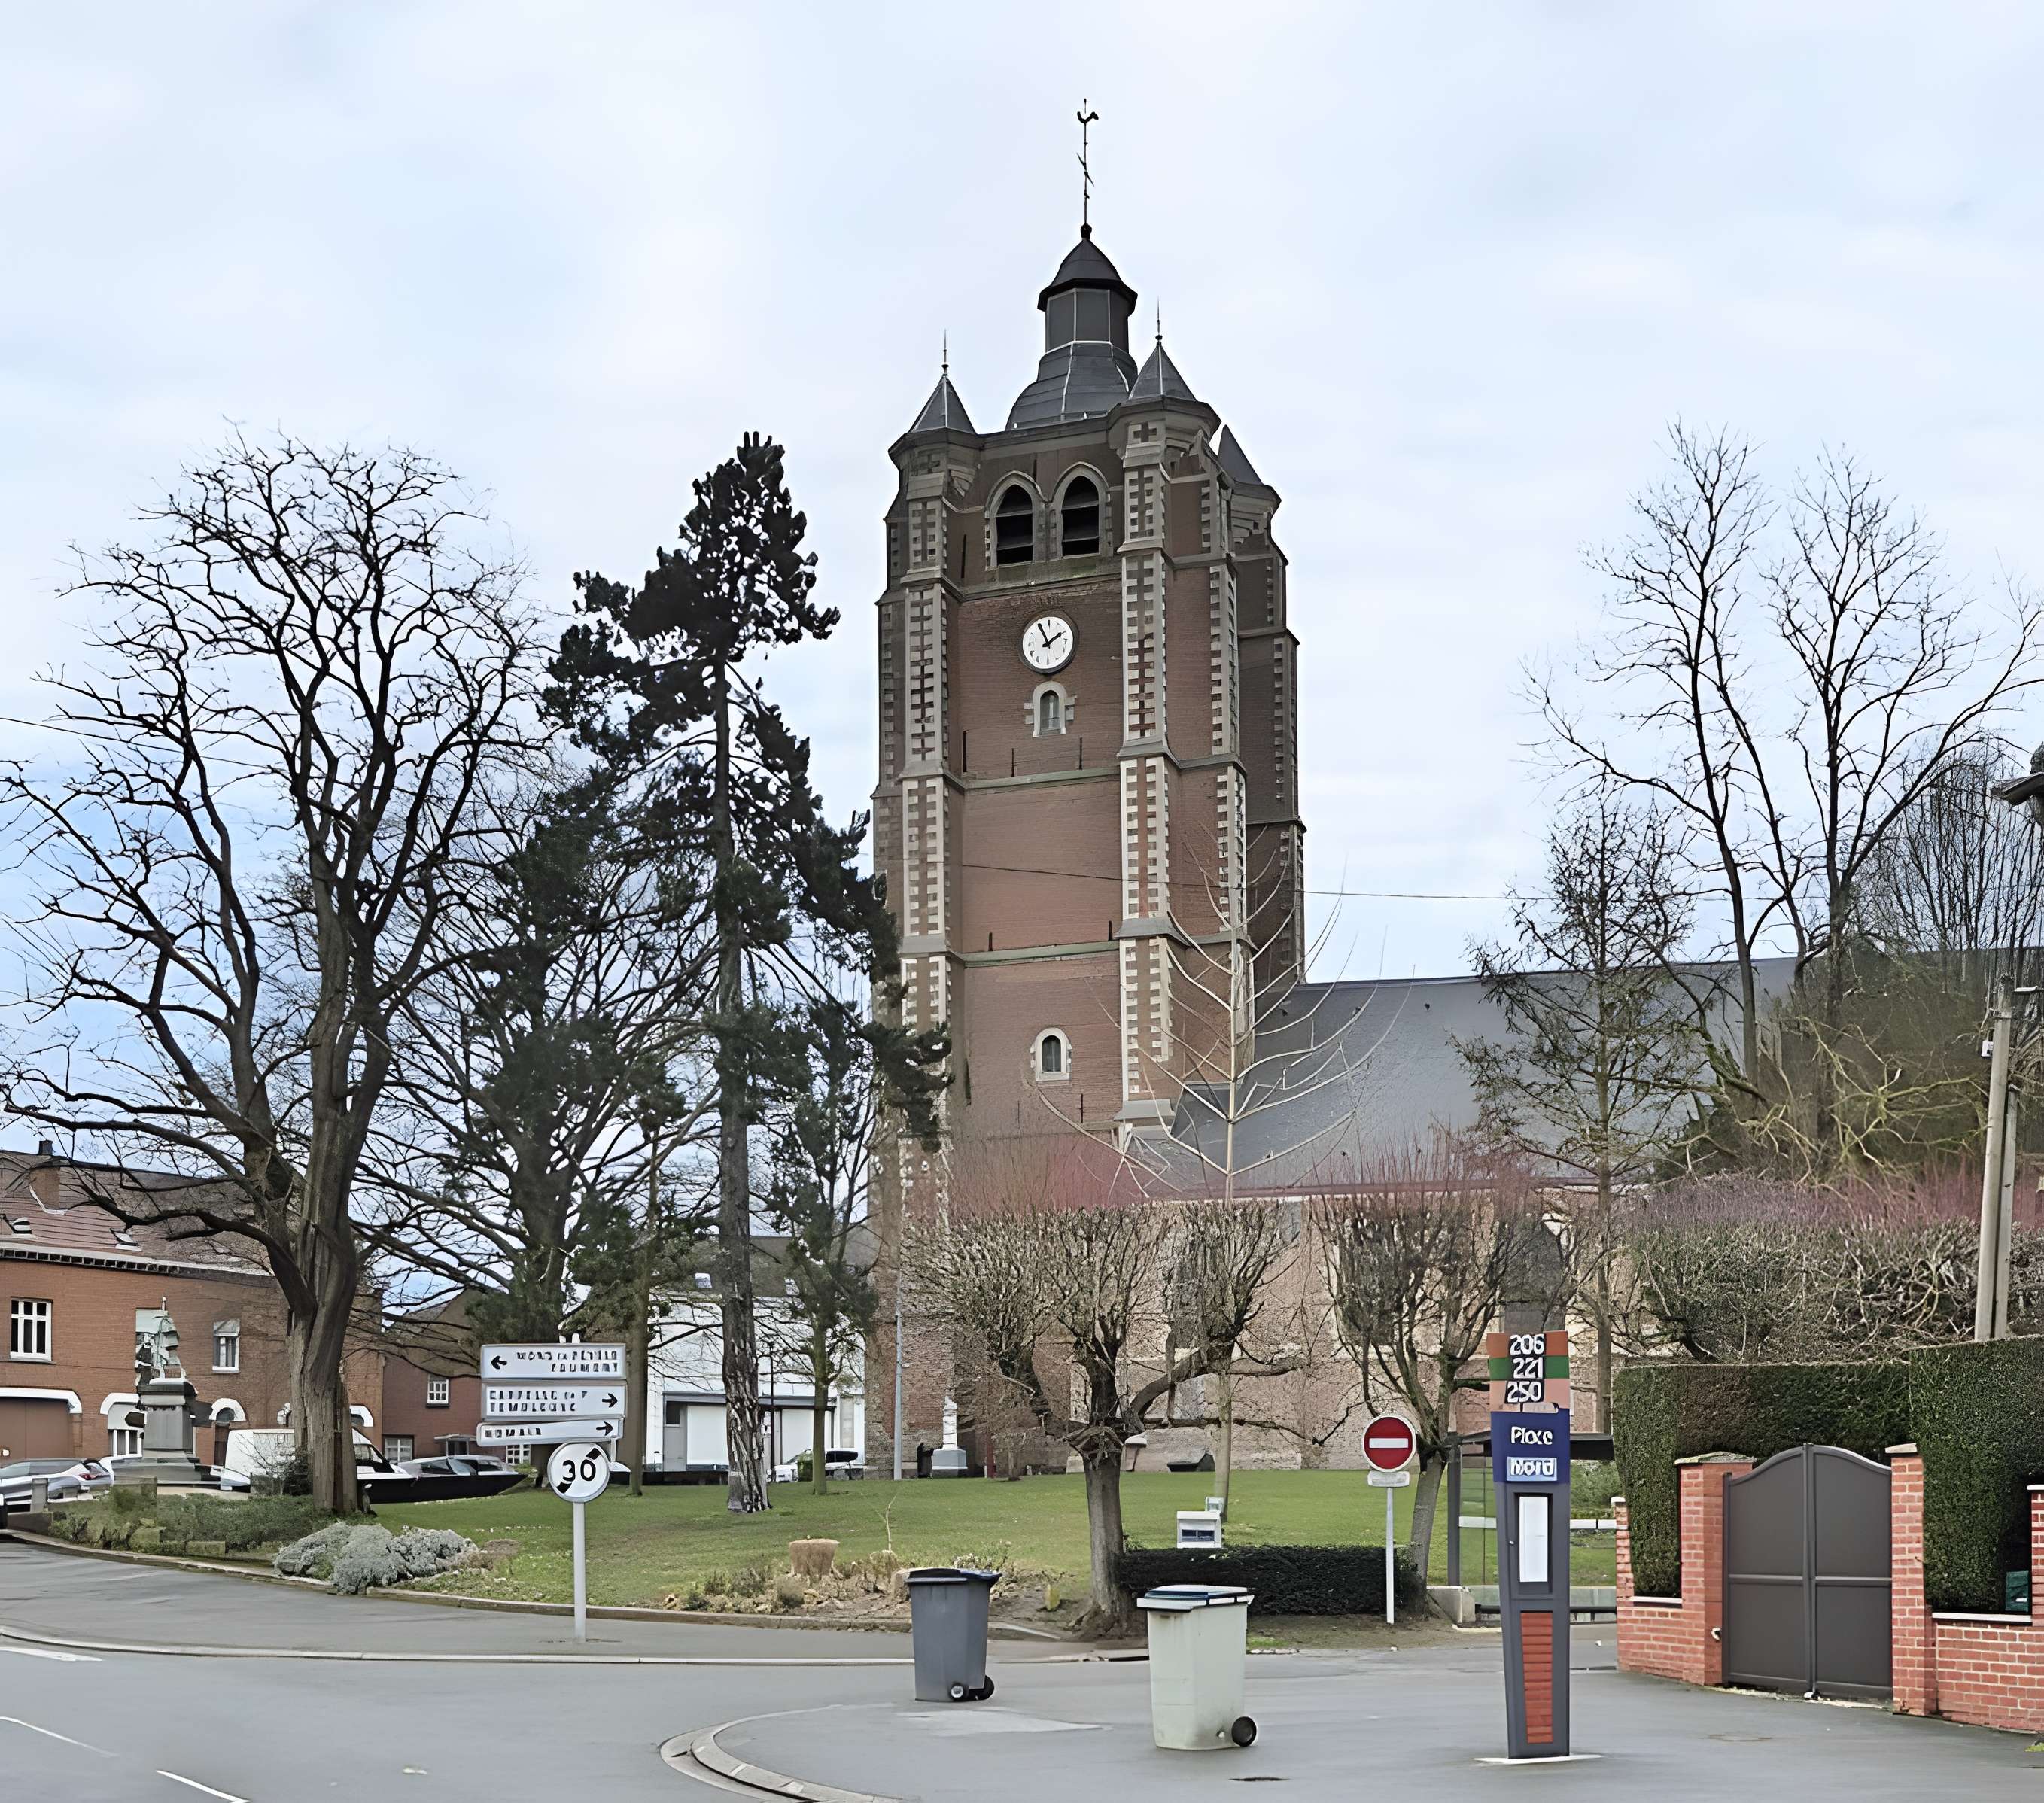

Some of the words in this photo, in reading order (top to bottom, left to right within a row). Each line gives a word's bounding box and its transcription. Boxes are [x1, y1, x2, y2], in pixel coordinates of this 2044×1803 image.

[1513, 1357, 1544, 1379] 221
[1507, 1381, 1541, 1403] 250
[562, 1459, 597, 1482] 30
